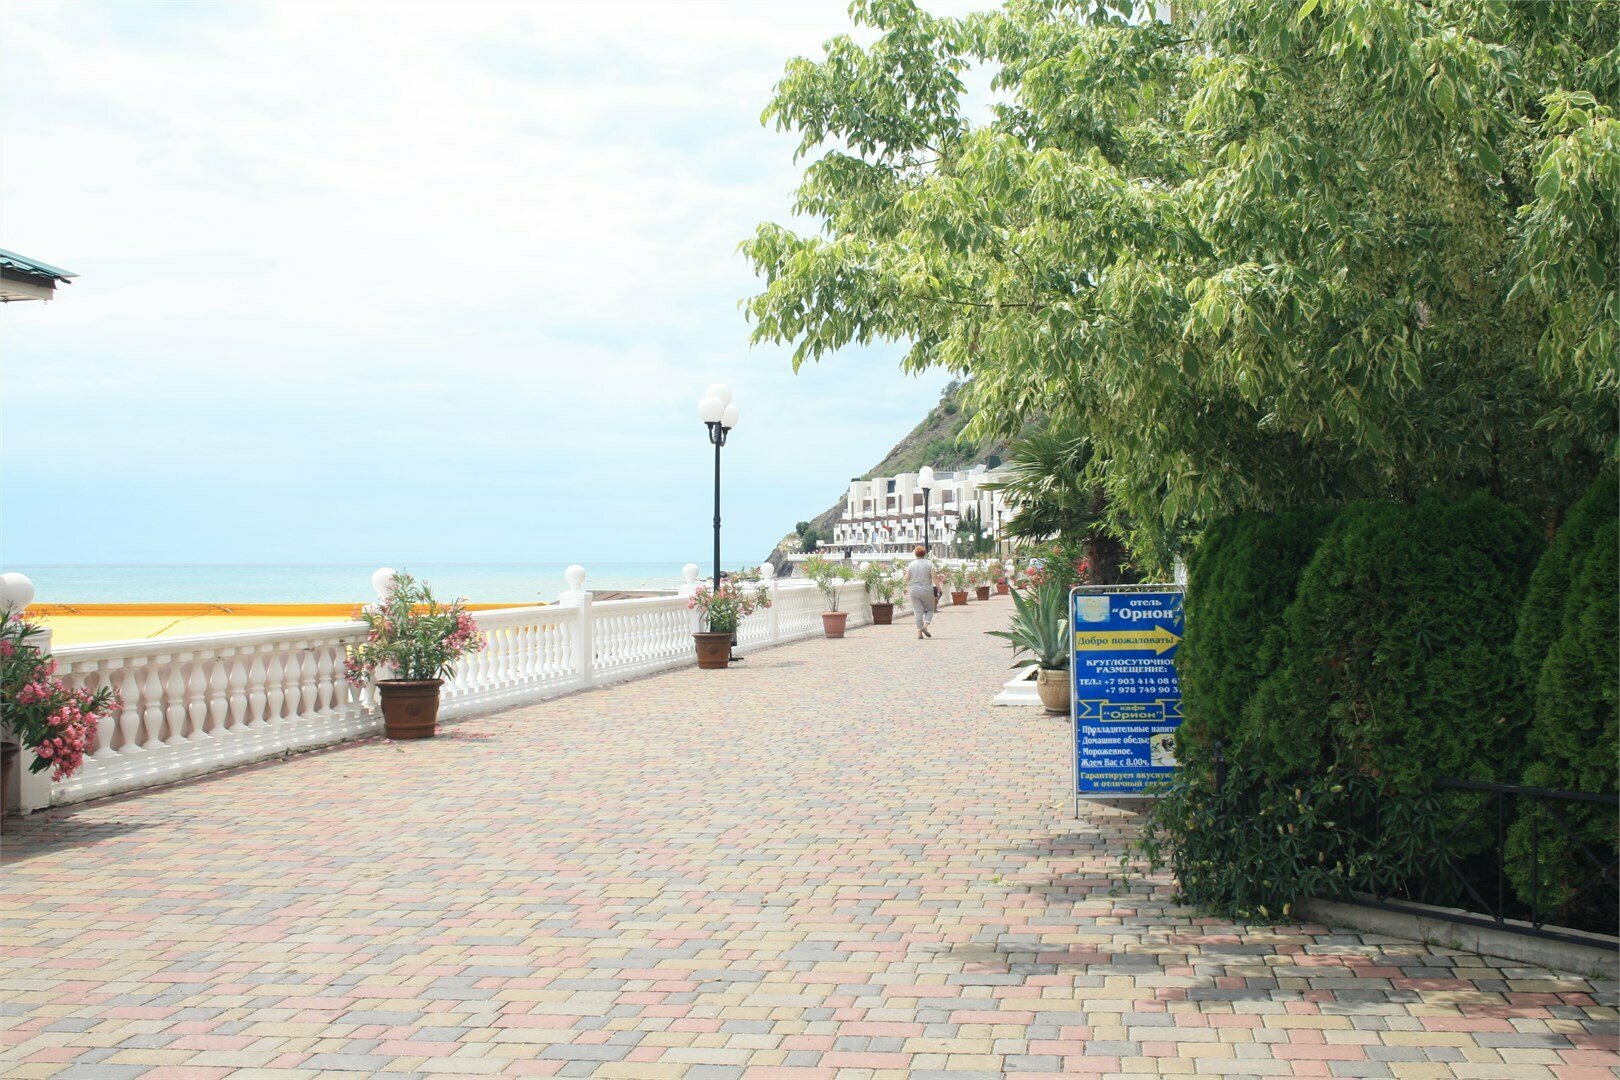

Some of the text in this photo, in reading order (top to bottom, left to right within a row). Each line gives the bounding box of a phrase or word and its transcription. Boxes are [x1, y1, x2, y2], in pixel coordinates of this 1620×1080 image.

[1078, 636, 1174, 646] Добро пожаловать!
[1117, 677, 1135, 685] 903
[1139, 686, 1156, 694] 749
[1158, 686, 1170, 694] 90
[1082, 725, 1149, 736] Прохладительные
[1082, 736, 1121, 745] Домашние
[1082, 748, 1133, 757] Мороженное.
[1081, 758, 1102, 767] Ждем
[1104, 758, 1119, 766] Вас
[1080, 772, 1134, 780] Гарантируем
